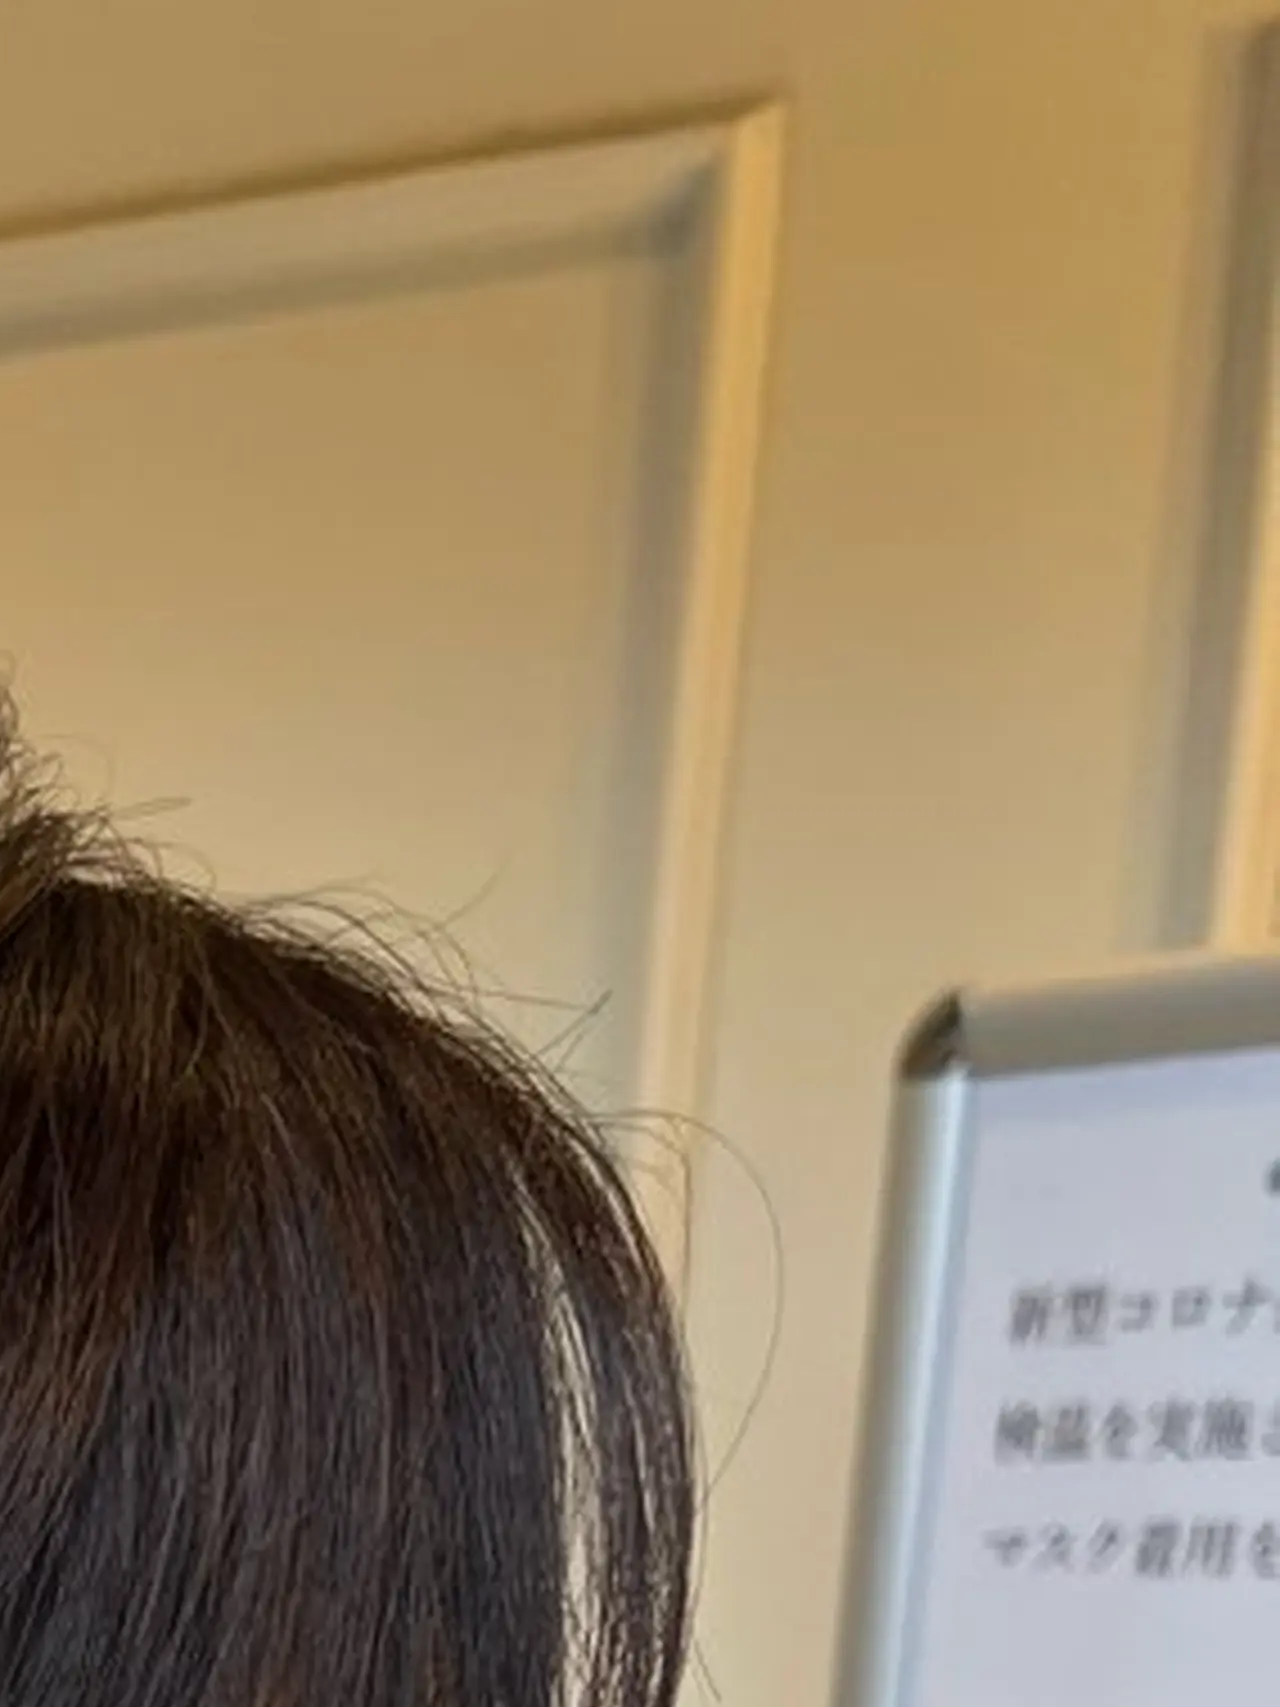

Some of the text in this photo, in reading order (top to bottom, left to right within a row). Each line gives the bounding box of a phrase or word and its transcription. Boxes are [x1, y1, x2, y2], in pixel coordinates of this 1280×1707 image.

[1007, 1280, 1280, 1348] 新型コロナ
